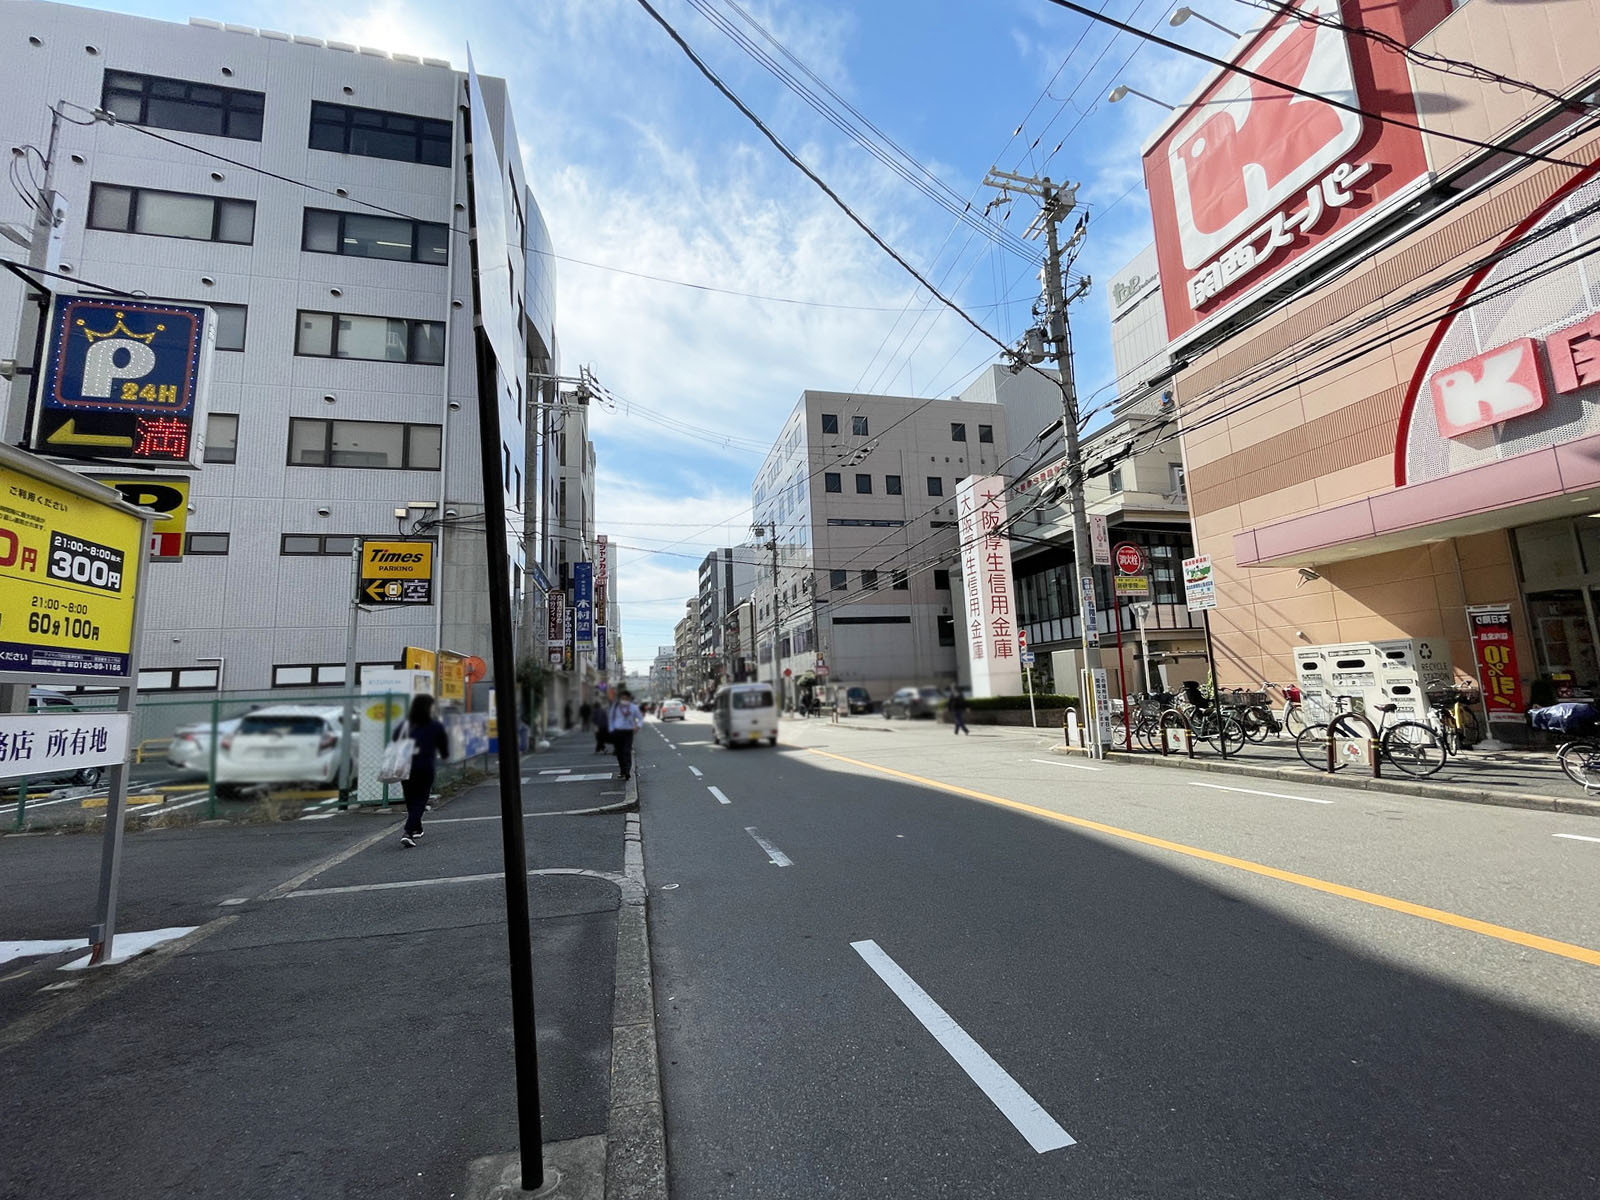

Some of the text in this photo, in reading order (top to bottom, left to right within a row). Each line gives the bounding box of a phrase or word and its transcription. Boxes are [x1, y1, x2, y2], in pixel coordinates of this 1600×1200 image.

[81, 338, 156, 398] P
[120, 383, 178, 403] 24H
[134, 416, 189, 459] 満
[9, 486, 68, 512] ご利用ください
[51, 550, 121, 590] 300円
[370, 549, 424, 563] Times
[960, 495, 985, 660] 大阪厚生信用金庫
[980, 490, 1013, 659] 大阪厚生信用金庫
[1421, 662, 1448, 671] RECYCLE
[1423, 672, 1450, 682] STATION
[45, 726, 108, 758] 所有地
